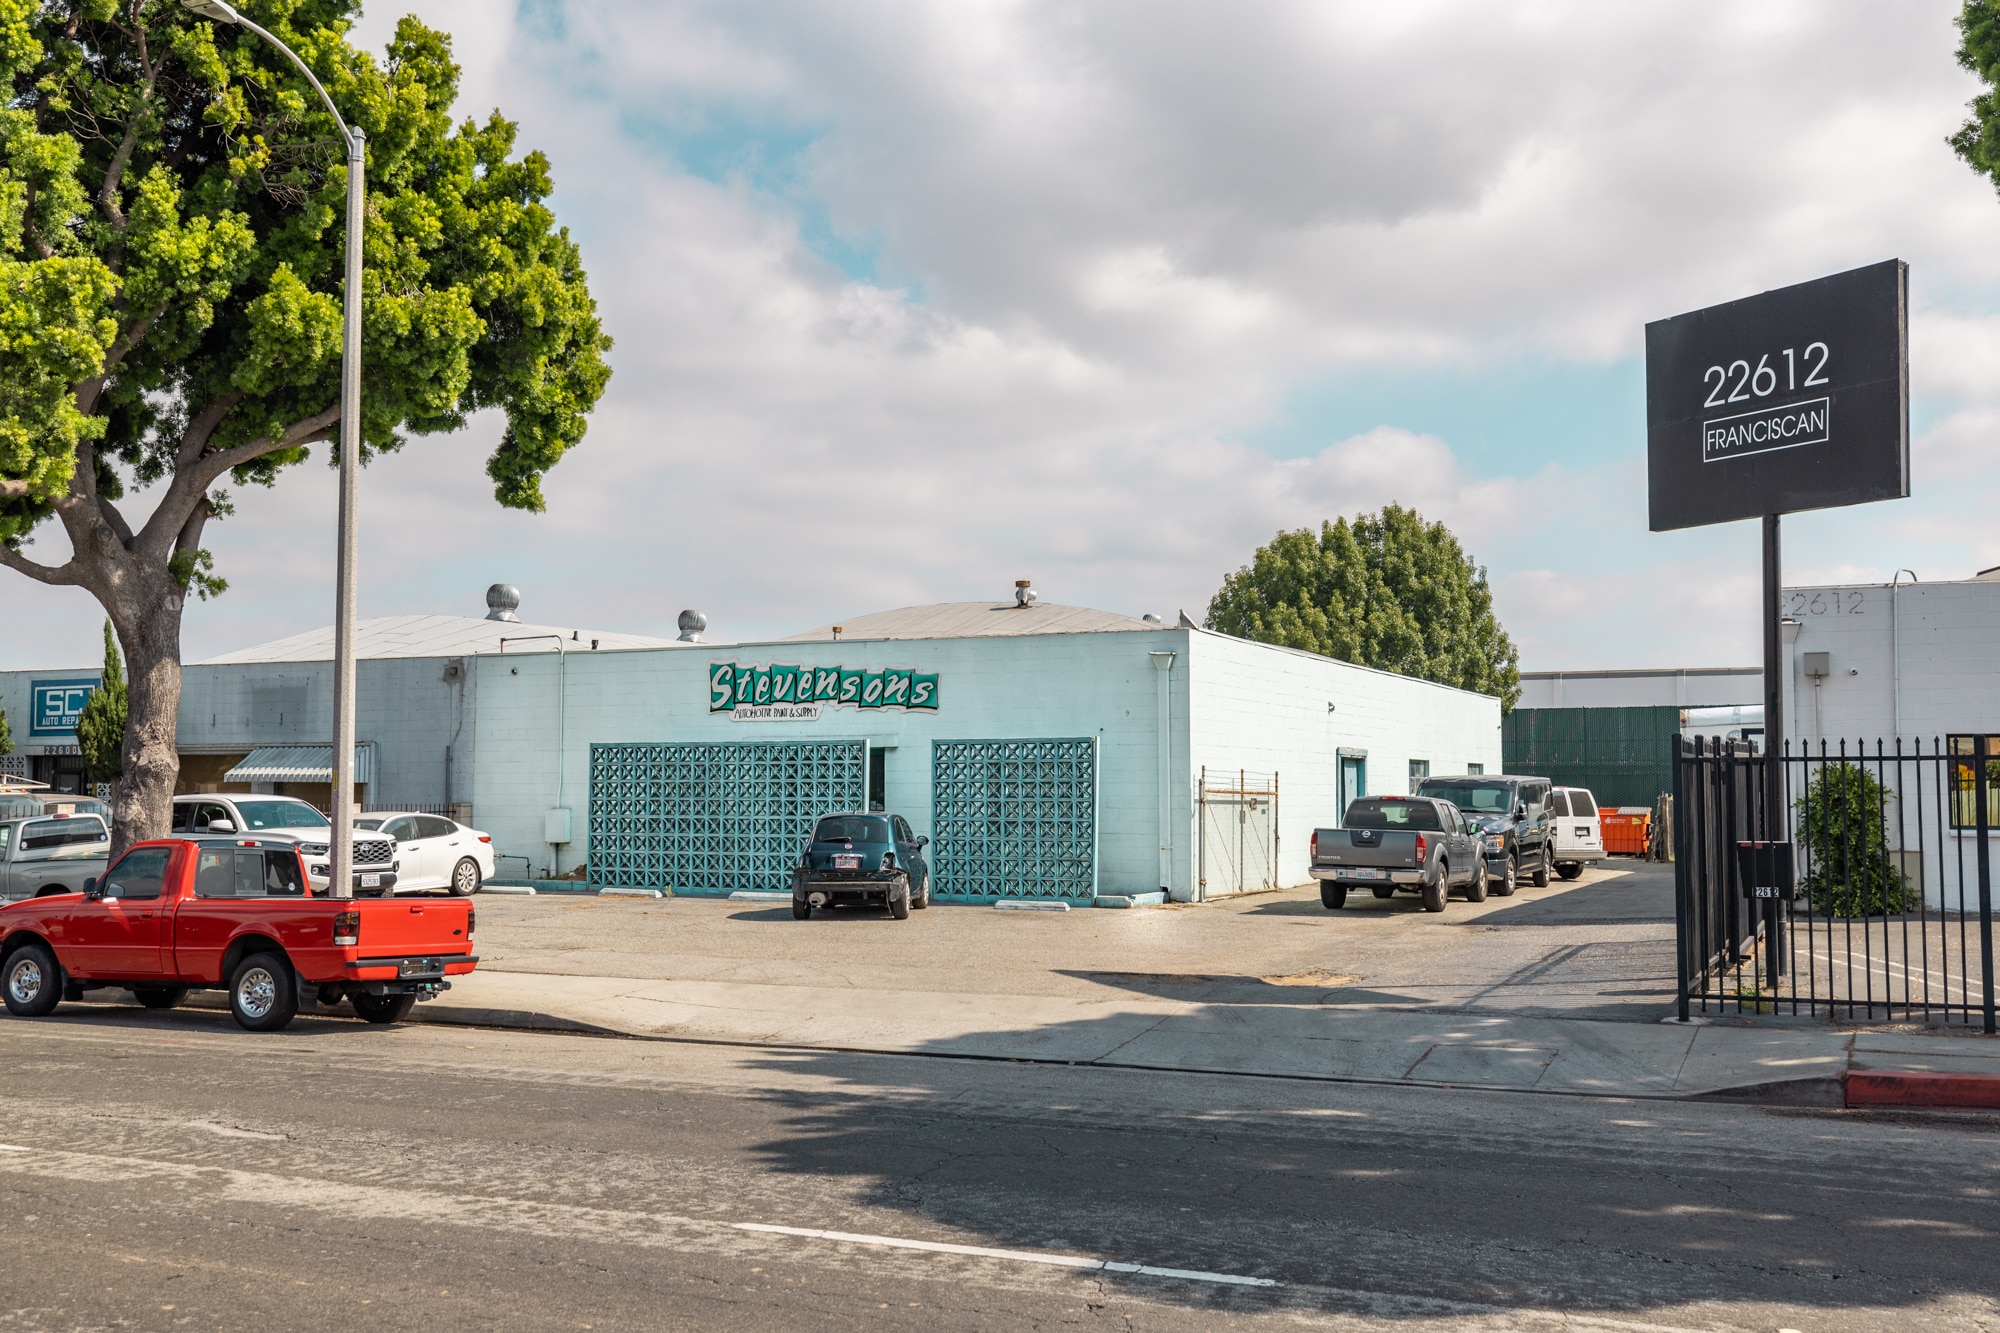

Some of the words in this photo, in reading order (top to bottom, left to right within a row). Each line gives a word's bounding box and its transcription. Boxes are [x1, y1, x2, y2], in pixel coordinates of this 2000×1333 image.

[1703, 341, 1830, 409] 22612
[1707, 408, 1825, 452] FRANCISCAN
[711, 665, 935, 709] Stevensons
[46, 689, 84, 716] SC
[734, 707, 772, 719] AUTOMOTIVE
[773, 707, 788, 718] PAINT
[789, 708, 795, 717] &
[795, 706, 818, 718] SUPPLY
[42, 716, 59, 726] AUTO
[45, 746, 77, 755] 22600
